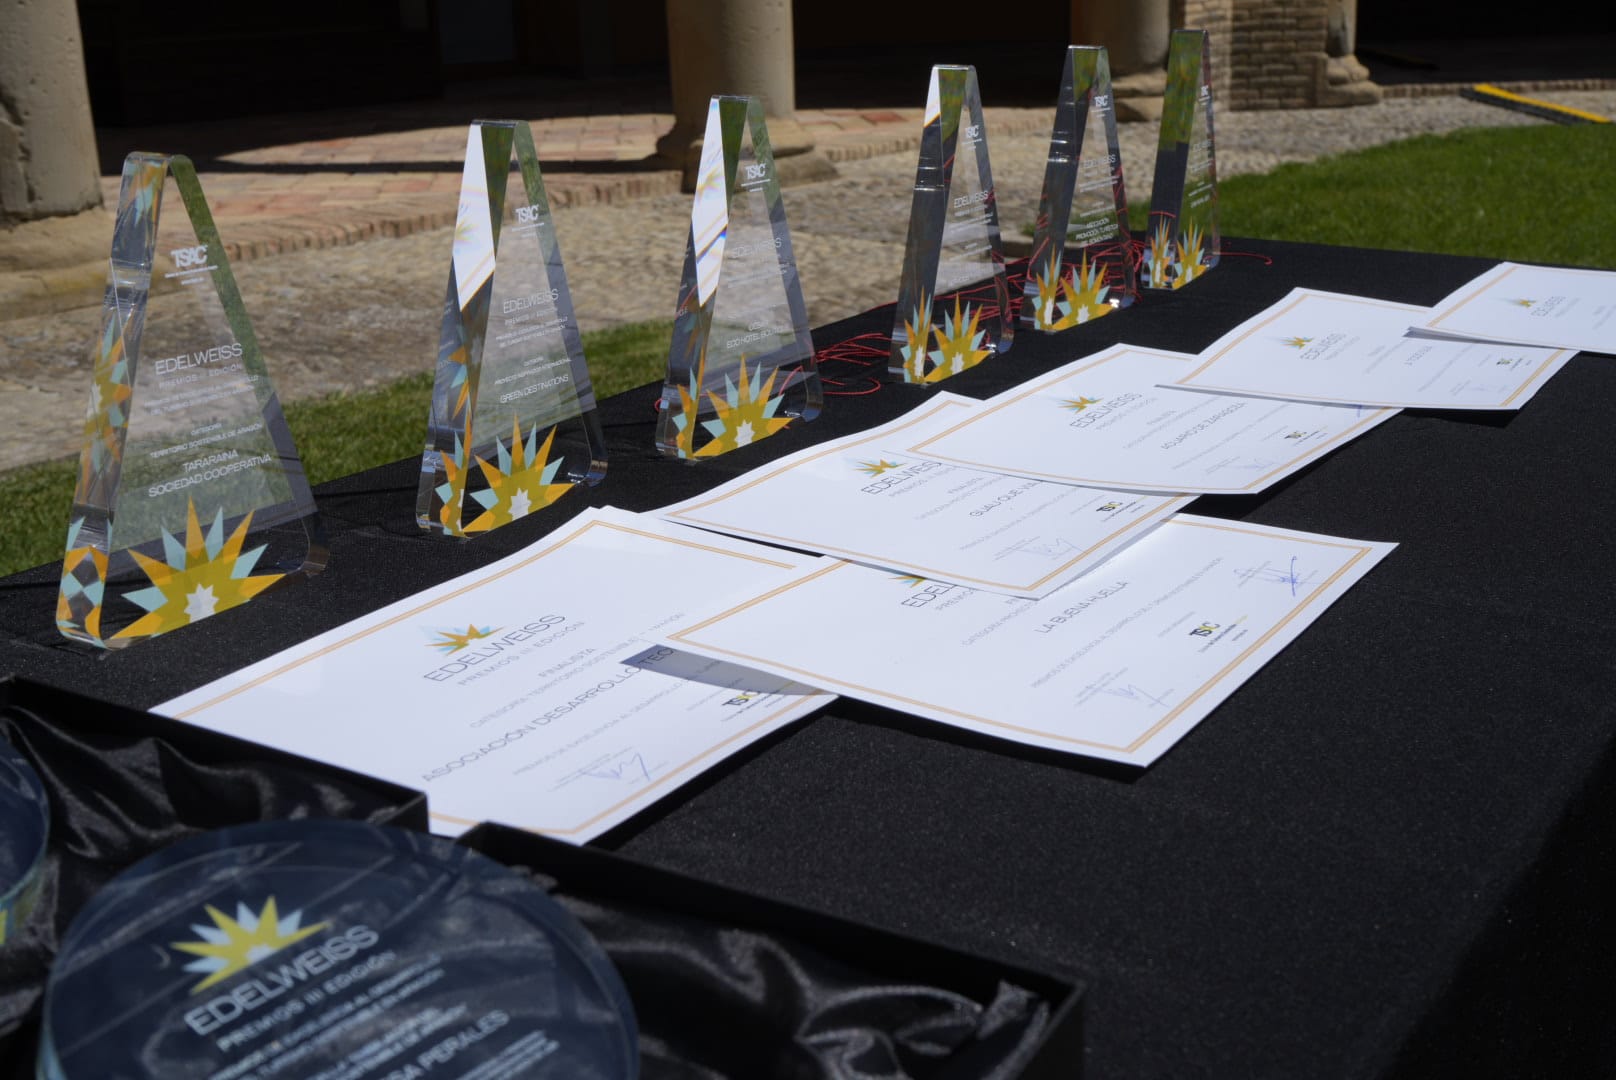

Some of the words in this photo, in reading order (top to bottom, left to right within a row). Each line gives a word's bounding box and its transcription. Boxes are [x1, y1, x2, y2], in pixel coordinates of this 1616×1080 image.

[515, 204, 539, 223] TSAC
[171, 245, 208, 268] TSAC
[503, 288, 559, 314] EDELWEISS
[155, 343, 243, 375] EDELWEISS
[524, 374, 569, 397] DESTINATIONS
[148, 474, 203, 497] SOCIEDAD
[203, 453, 272, 482] COOPERATIVA
[424, 614, 566, 682] EDELWEISS
[458, 655, 520, 685] PREMIOS
[531, 667, 642, 726] DESARROLLO
[183, 923, 379, 1037] EDELWEISS
[216, 999, 306, 1051] PREMIOS
[417, 1008, 510, 1070] PERALES
